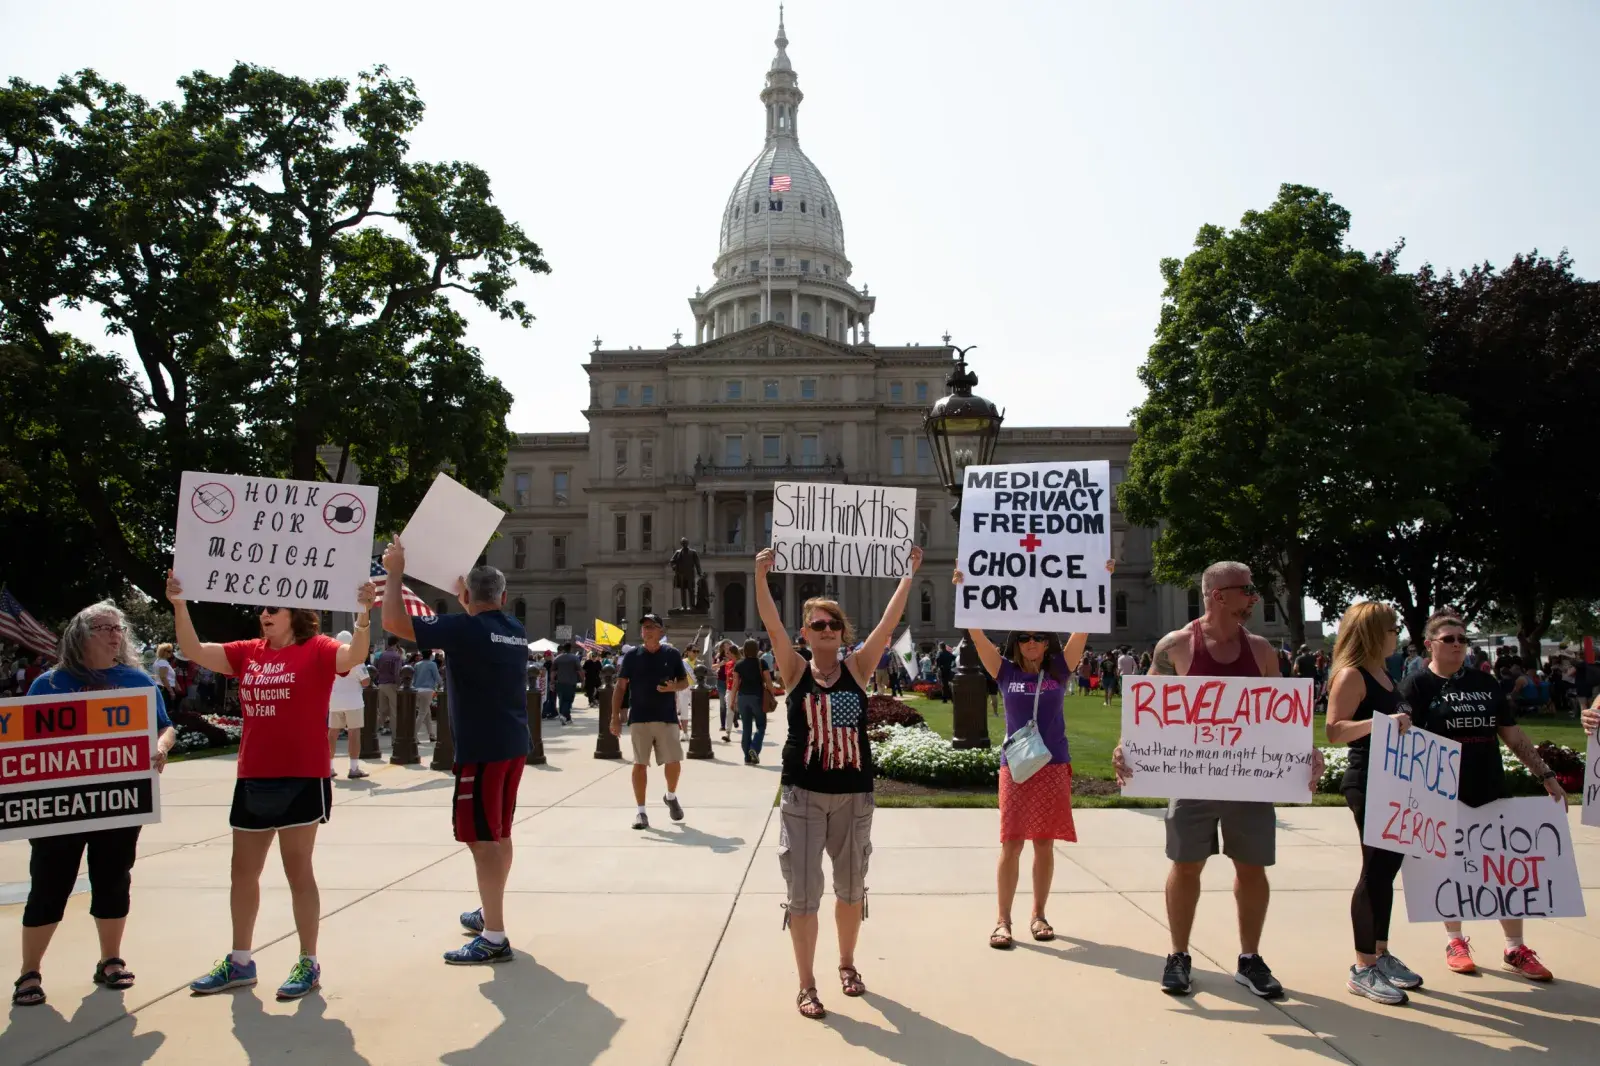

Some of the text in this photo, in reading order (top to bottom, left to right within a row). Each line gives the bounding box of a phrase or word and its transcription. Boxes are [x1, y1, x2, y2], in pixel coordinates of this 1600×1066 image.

[967, 468, 1099, 489] MEDICAL
[245, 481, 320, 506] HONK
[994, 488, 1105, 512] PRIVACY
[252, 510, 305, 533] FOR
[774, 484, 909, 539] Still think this
[973, 512, 1105, 534] FREEDOM
[208, 536, 336, 568] MEDICAL
[772, 534, 914, 578] is about a virus?
[968, 549, 1087, 579] CHOICE
[206, 570, 330, 600] FREEDOM
[962, 584, 1018, 611] FOR
[253, 687, 291, 701] VACCINE
[1007, 682, 1026, 693] FREE
[1442, 691, 1493, 702] YRANNY
[255, 703, 276, 717] FEAR
[1131, 680, 1313, 729] REVELATION
[1451, 703, 1486, 713] with a
[35, 706, 77, 734] NO
[102, 705, 131, 728] TO
[1445, 716, 1497, 730] NEEDLE
[1194, 725, 1243, 747] 13:17
[0, 744, 138, 778] CCINATION
[1135, 760, 1161, 773] Save
[1163, 760, 1178, 774] he
[1177, 761, 1206, 775] that
[1207, 760, 1229, 777] had
[1230, 762, 1252, 777] the
[1151, 741, 1179, 757] that
[1179, 746, 1194, 759] no
[1194, 748, 1219, 760] man
[1222, 746, 1258, 765] might
[1261, 745, 1283, 770] buy
[1384, 723, 1460, 800] HEROES
[1408, 787, 1419, 810] to
[1381, 801, 1447, 859] ZEROS
[1463, 854, 1546, 889] is NOT
[1435, 878, 1553, 919] CHOICE!
